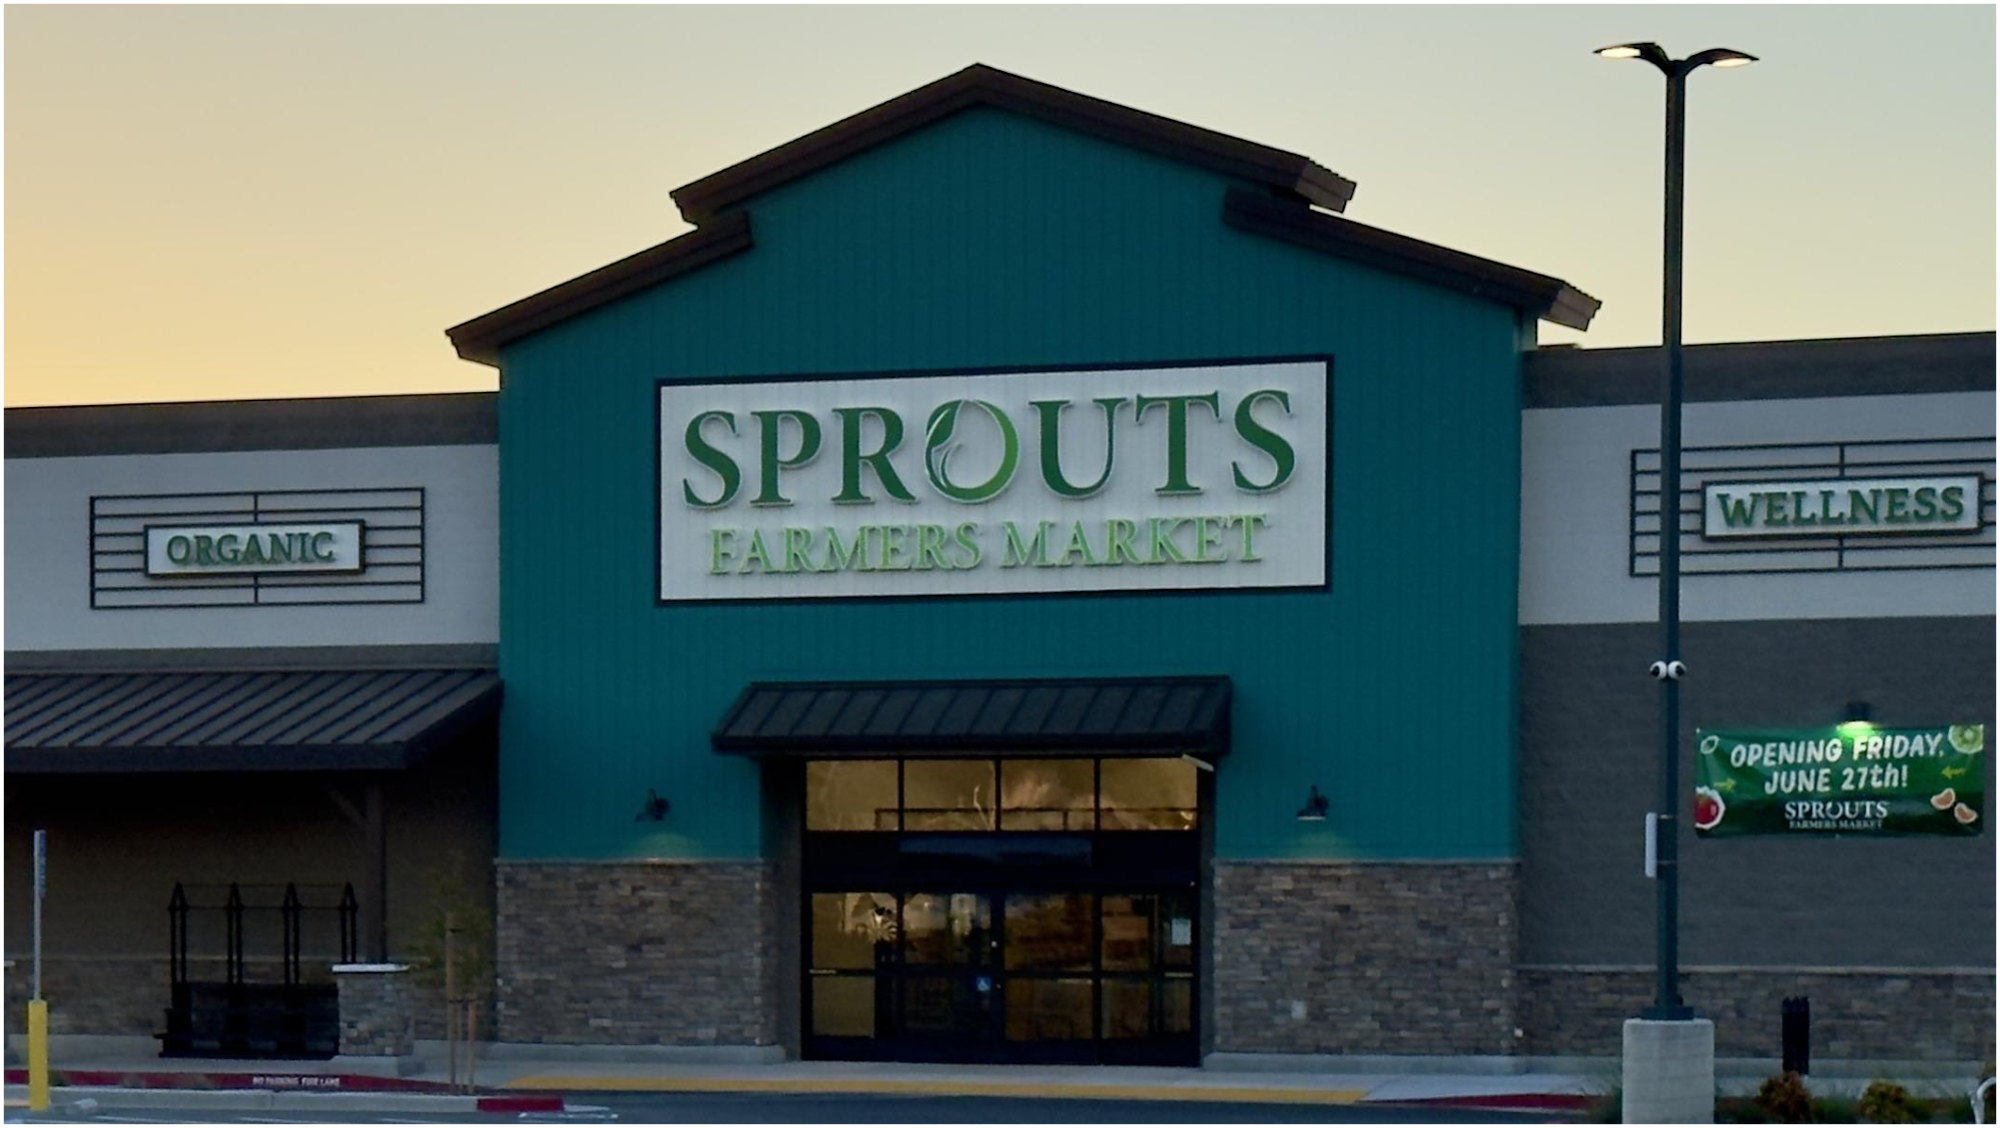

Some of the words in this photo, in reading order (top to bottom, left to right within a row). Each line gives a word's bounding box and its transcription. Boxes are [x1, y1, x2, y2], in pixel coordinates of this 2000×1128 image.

[683, 390, 1296, 507] SPROUTS
[1716, 486, 1965, 528] WELLNESS
[167, 531, 335, 566] ORGANIC
[708, 521, 982, 575] FARMERS
[1003, 513, 1268, 567] MARKET
[1730, 738, 1843, 768] OPENING
[1764, 769, 1832, 795] JUNE
[1841, 764, 1909, 792] 27th!
[1784, 800, 1889, 820] SPROUTS
[1790, 819, 1836, 830] FARMERS
[1839, 819, 1882, 830] MARKET
